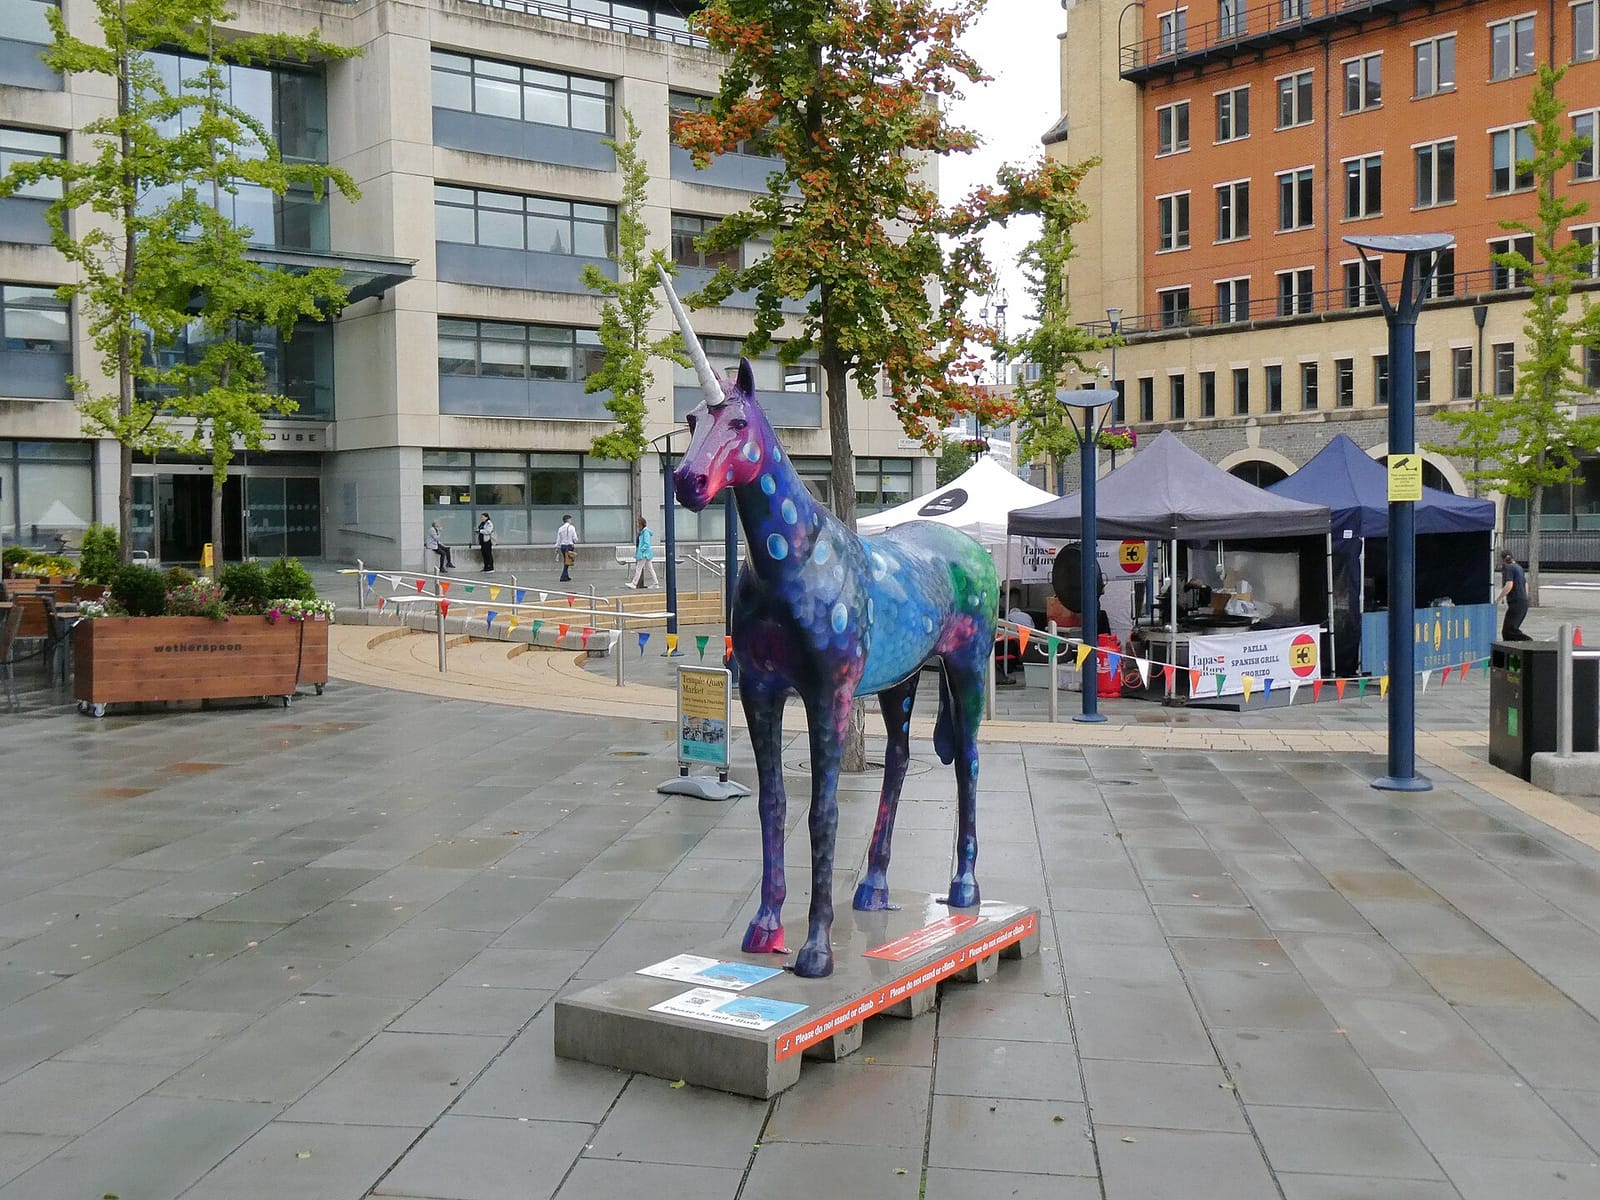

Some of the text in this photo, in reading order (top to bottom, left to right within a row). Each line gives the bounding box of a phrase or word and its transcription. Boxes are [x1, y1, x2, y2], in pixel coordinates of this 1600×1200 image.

[267, 432, 317, 442] OUSE
[1022, 555, 1055, 566] Cutur
[153, 642, 242, 653] wetherspoon
[1243, 644, 1268, 653] PAELLA
[1192, 655, 1217, 670] Tapas
[1231, 655, 1280, 667] SPANISH GRILL
[682, 674, 724, 689] Temple Quay
[682, 683, 704, 695] Market
[969, 946, 983, 959] Please
[988, 938, 996, 949] not
[1012, 924, 1025, 936] climb
[889, 959, 956, 999] Please do not stand or climb
[795, 1000, 874, 1045] Please do not stand or climb
